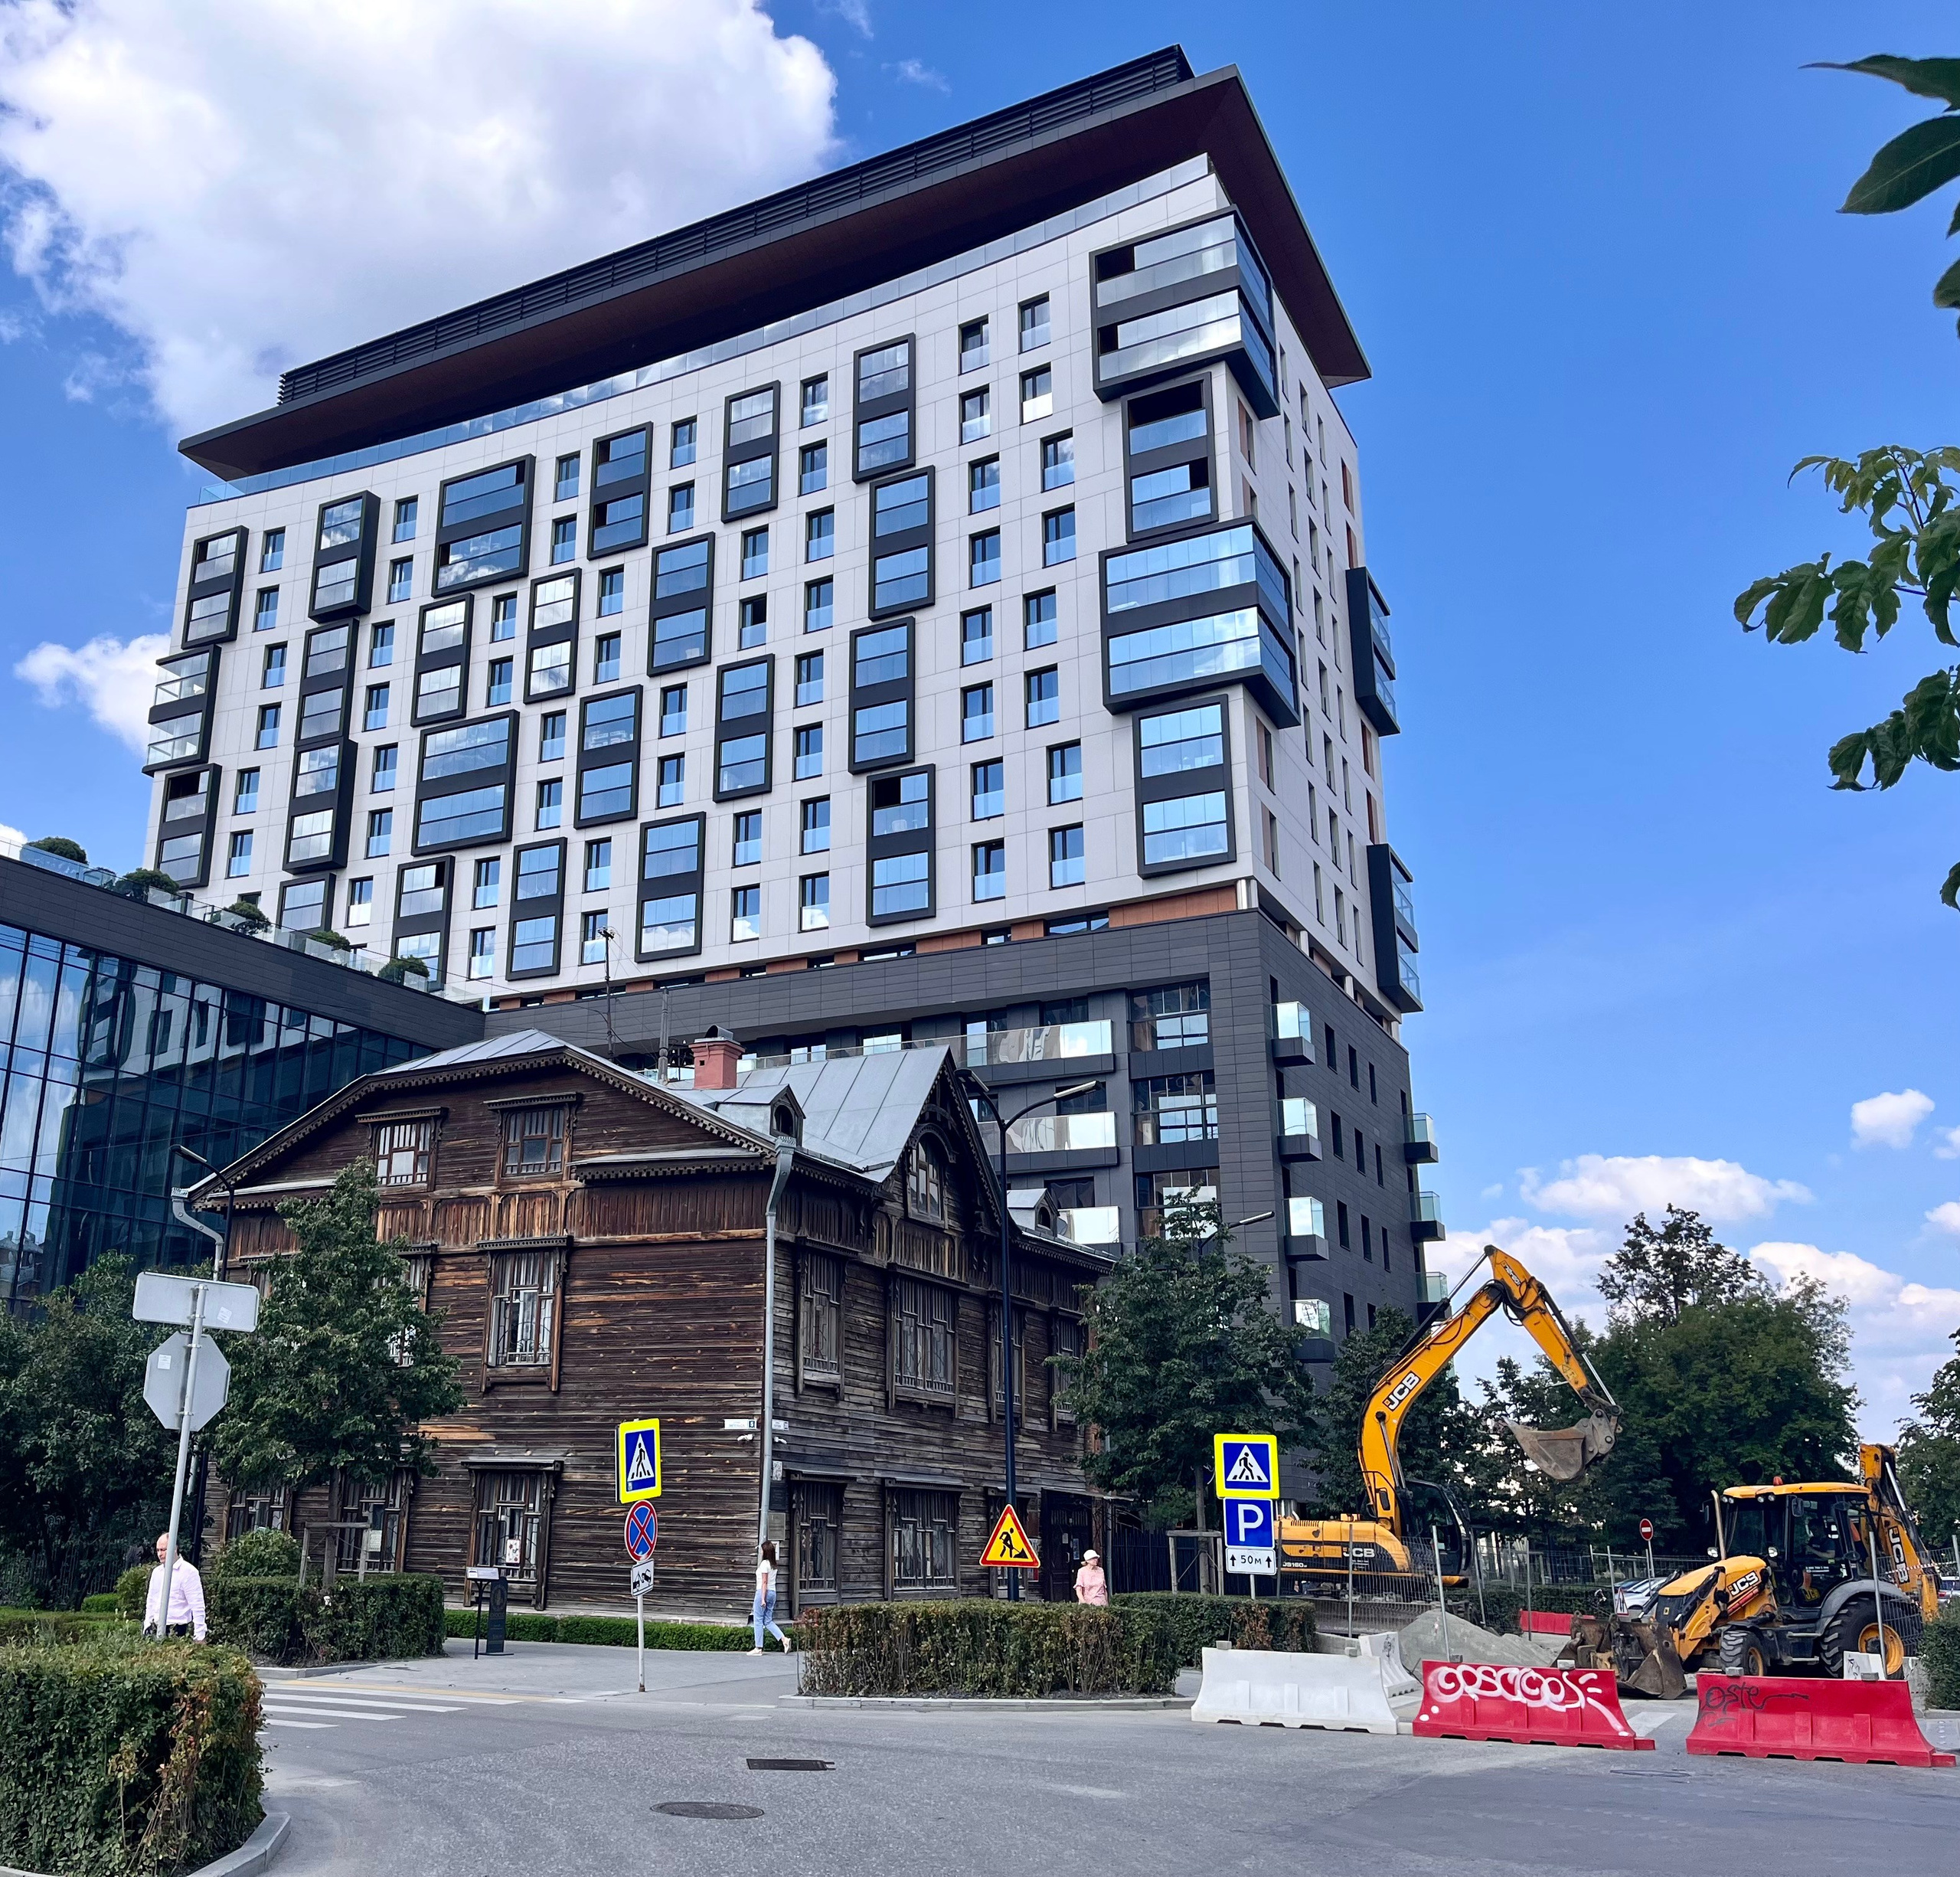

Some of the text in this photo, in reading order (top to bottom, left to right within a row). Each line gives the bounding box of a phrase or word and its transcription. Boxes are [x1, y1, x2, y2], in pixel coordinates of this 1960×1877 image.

[1387, 1372, 1420, 1410] JCB
[1238, 1503, 1264, 1542] P
[1342, 1547, 1375, 1558] JCB
[1889, 1528, 1909, 1584] JCB
[1730, 1571, 1759, 1596] JCB
